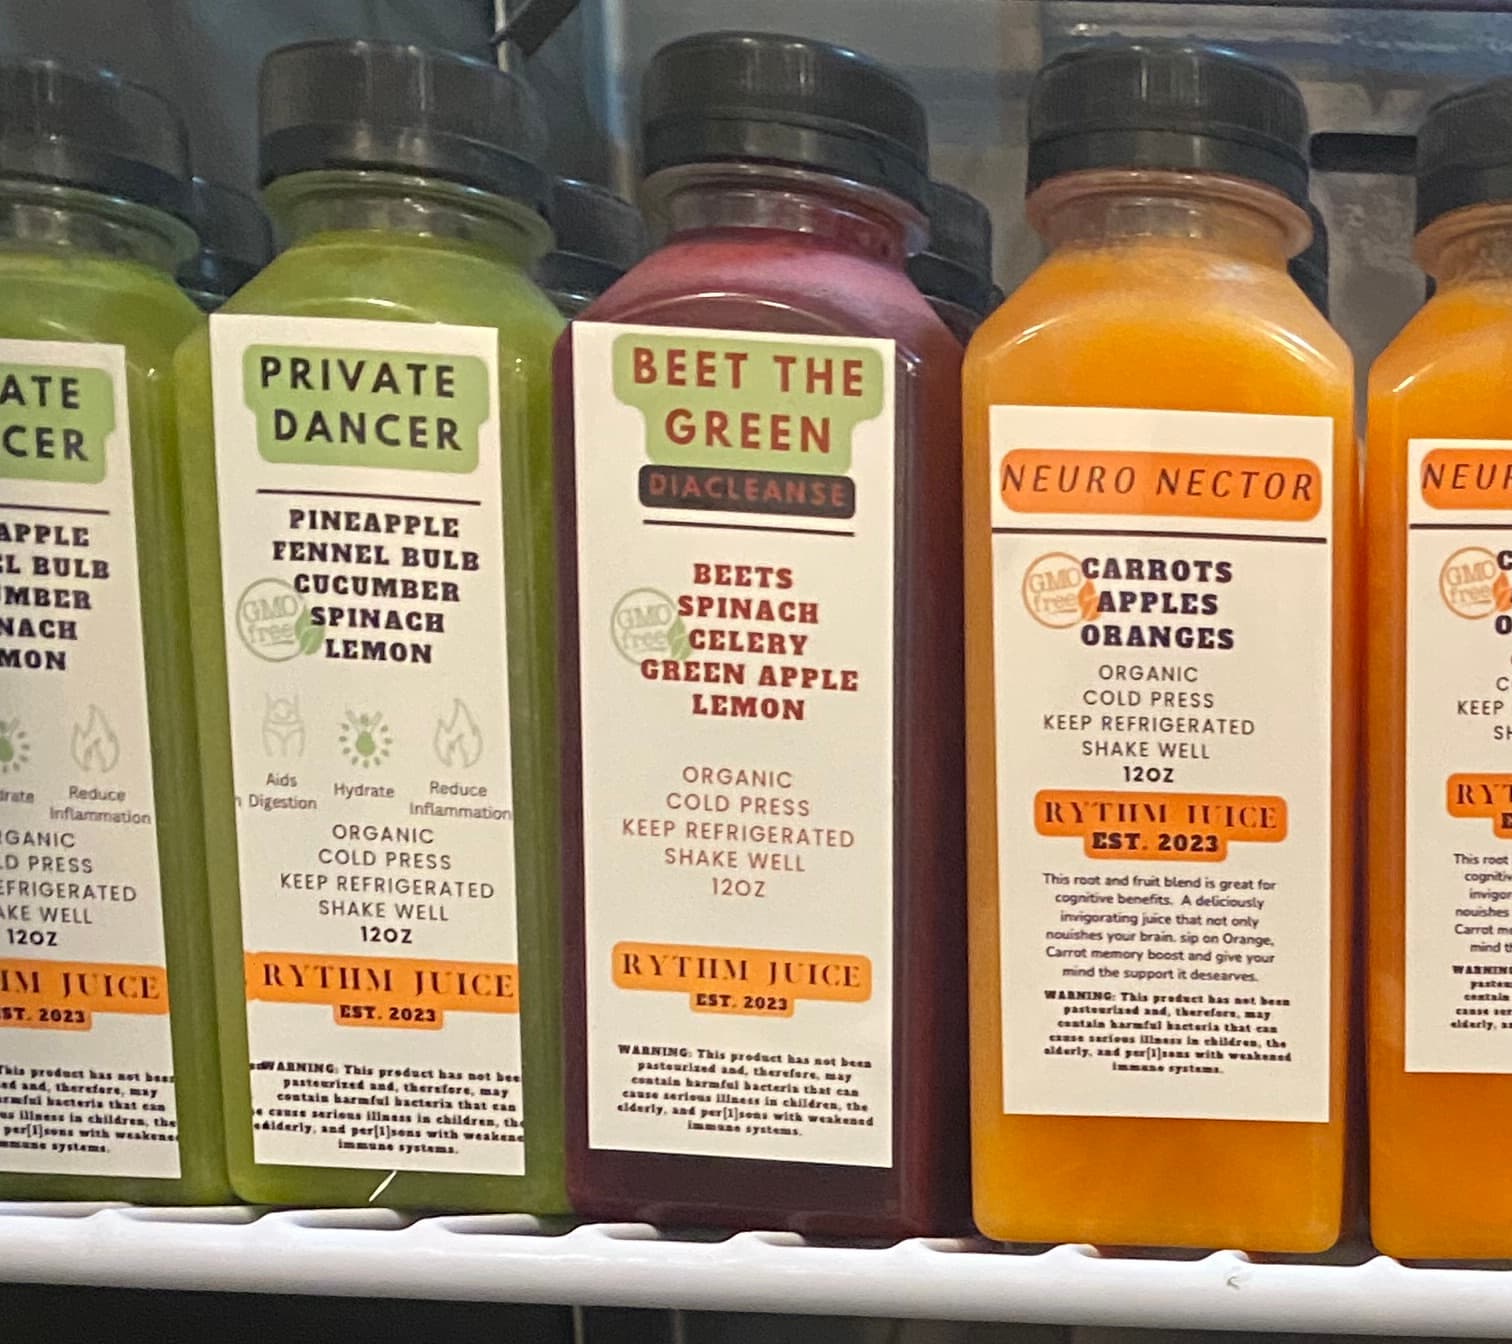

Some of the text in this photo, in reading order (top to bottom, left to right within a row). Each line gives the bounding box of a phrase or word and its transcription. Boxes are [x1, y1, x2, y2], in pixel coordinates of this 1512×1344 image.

[261, 356, 455, 398] PRIVATE
[633, 347, 863, 396] BEET THE
[274, 409, 462, 451] DANCER
[665, 409, 831, 453] GREEN
[650, 474, 845, 506] DIACLEANSE
[1002, 463, 1314, 501] NEURO NECTOR
[289, 509, 459, 538] PINEAPPLE
[33, 555, 110, 580] BULB
[272, 541, 479, 572] FENNEL BULB
[693, 563, 793, 589] BEETS
[1081, 558, 1233, 583] CARROTS
[294, 574, 460, 603] CUCUMBER
[677, 596, 819, 624] SPINACH
[1096, 591, 1218, 615] APPLES
[689, 629, 808, 656] CELERY
[1080, 625, 1235, 650] ORANGES
[641, 660, 859, 691] GREEN APPLE
[1083, 690, 1215, 709] COLD PRESS
[1082, 741, 1210, 759] SHAKE WELL
[683, 766, 793, 789] ORGANIC
[333, 782, 395, 800] Hydrate
[280, 873, 494, 899] KEEP REFRIGERATED
[712, 878, 766, 898] 12OZ
[1043, 873, 1276, 892] This root and fruit blend is great for
[43, 906, 93, 925] WELL
[7, 929, 58, 947] 12OZ
[62, 971, 161, 1000] JUICE
[264, 963, 513, 998] RYTHM JUICE
[696, 993, 788, 1011] EST. 2023
